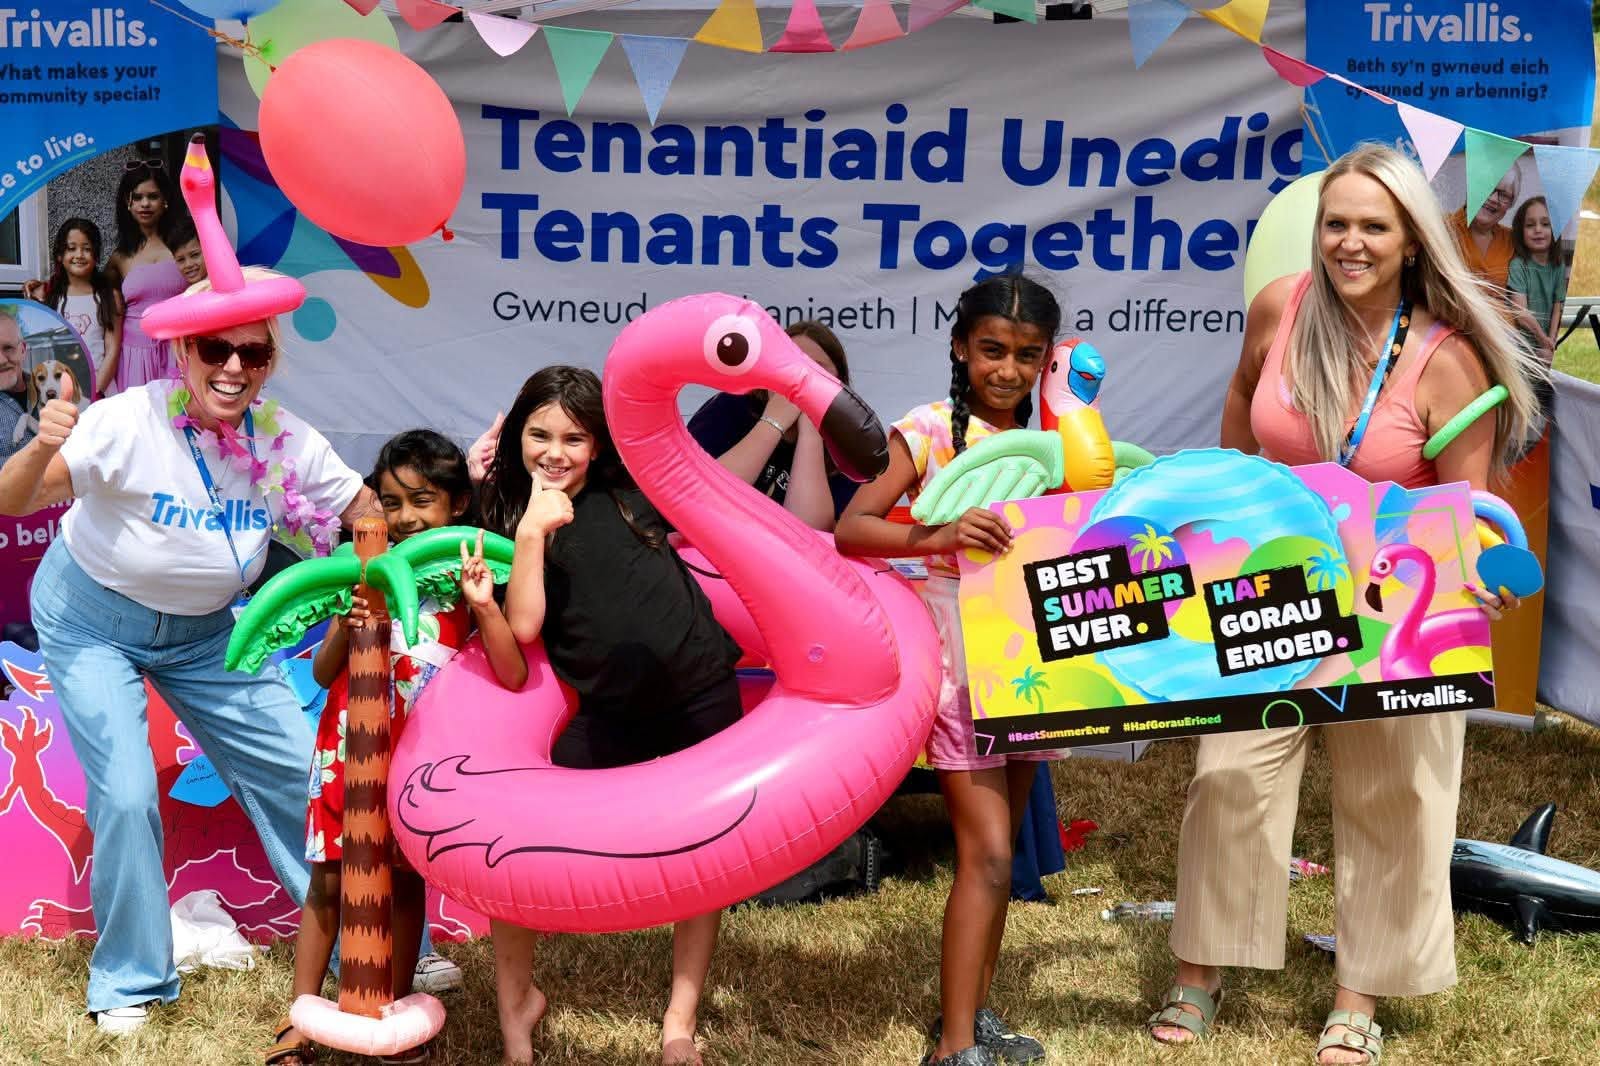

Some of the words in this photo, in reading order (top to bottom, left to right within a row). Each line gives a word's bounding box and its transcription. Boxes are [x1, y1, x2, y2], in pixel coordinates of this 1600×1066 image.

[1364, 1, 1533, 43] Trivallis.
[47, 61, 108, 80] makes
[114, 64, 158, 81] your
[1346, 58, 1385, 73] Beth
[1391, 60, 1425, 76] sy'n
[1431, 58, 1504, 77] gwneud
[1510, 59, 1549, 75] eich
[0, 86, 87, 106] ommunity
[93, 85, 161, 104] special?
[1428, 85, 1450, 100] yn
[1455, 82, 1548, 102] arbennig?
[43, 132, 95, 160] live.
[481, 103, 968, 182] Tenantiaid
[481, 192, 839, 269] Tenants
[863, 195, 1255, 284] Togethe
[493, 291, 647, 324] Gwneud
[764, 298, 895, 330] aniaeth
[1075, 308, 1094, 332] a
[1108, 298, 1245, 333] differen
[1036, 554, 1111, 592] BEST
[1212, 574, 1271, 606] HAF
[1043, 573, 1185, 622] SUMMER
[1049, 614, 1149, 651] EVER.
[1219, 597, 1322, 638] GORAU
[1225, 629, 1349, 671] ERIOED.
[1376, 684, 1474, 711] Trivallis.
[1008, 724, 1111, 743] #BestSummerEver
[1122, 714, 1222, 733] #HafGorauErioed
